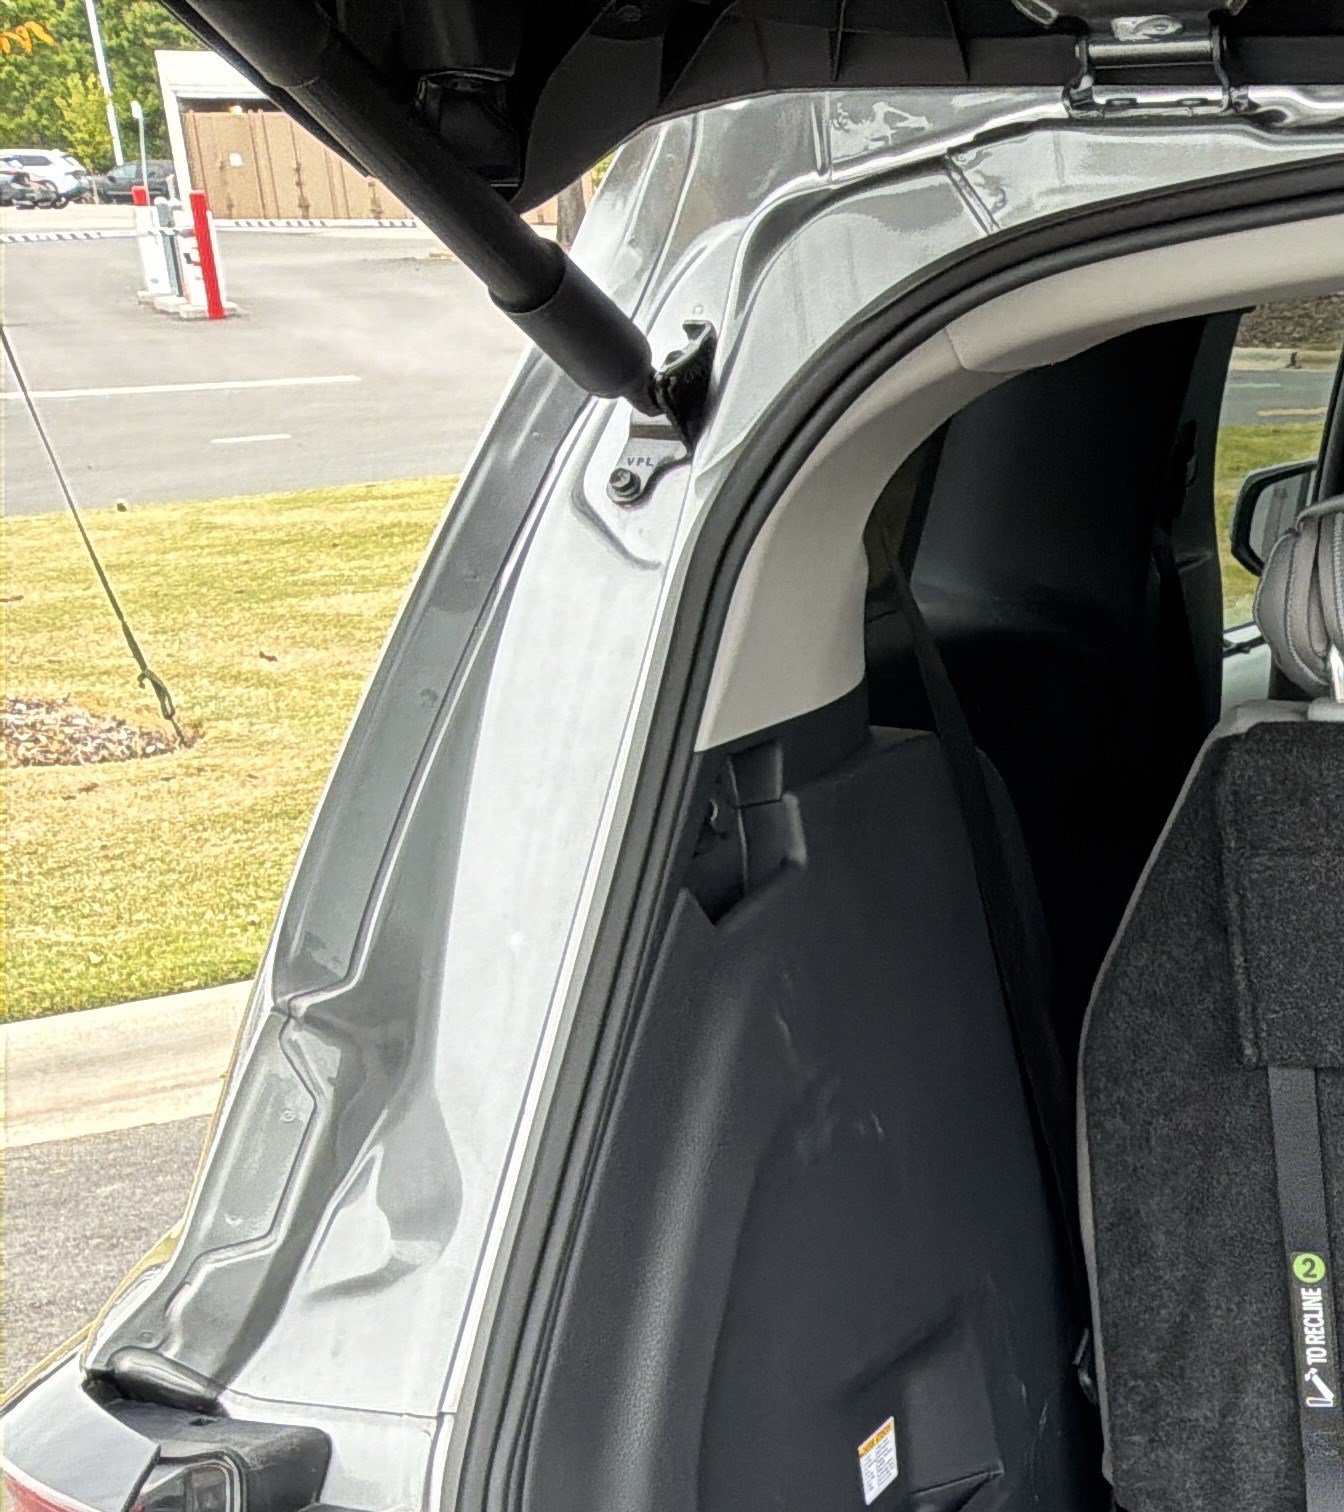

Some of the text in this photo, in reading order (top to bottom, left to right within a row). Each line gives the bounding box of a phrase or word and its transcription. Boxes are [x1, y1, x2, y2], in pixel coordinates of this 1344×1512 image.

[1301, 1257, 1317, 1278] 2
[1301, 1287, 1328, 1366] TO RECLINE
